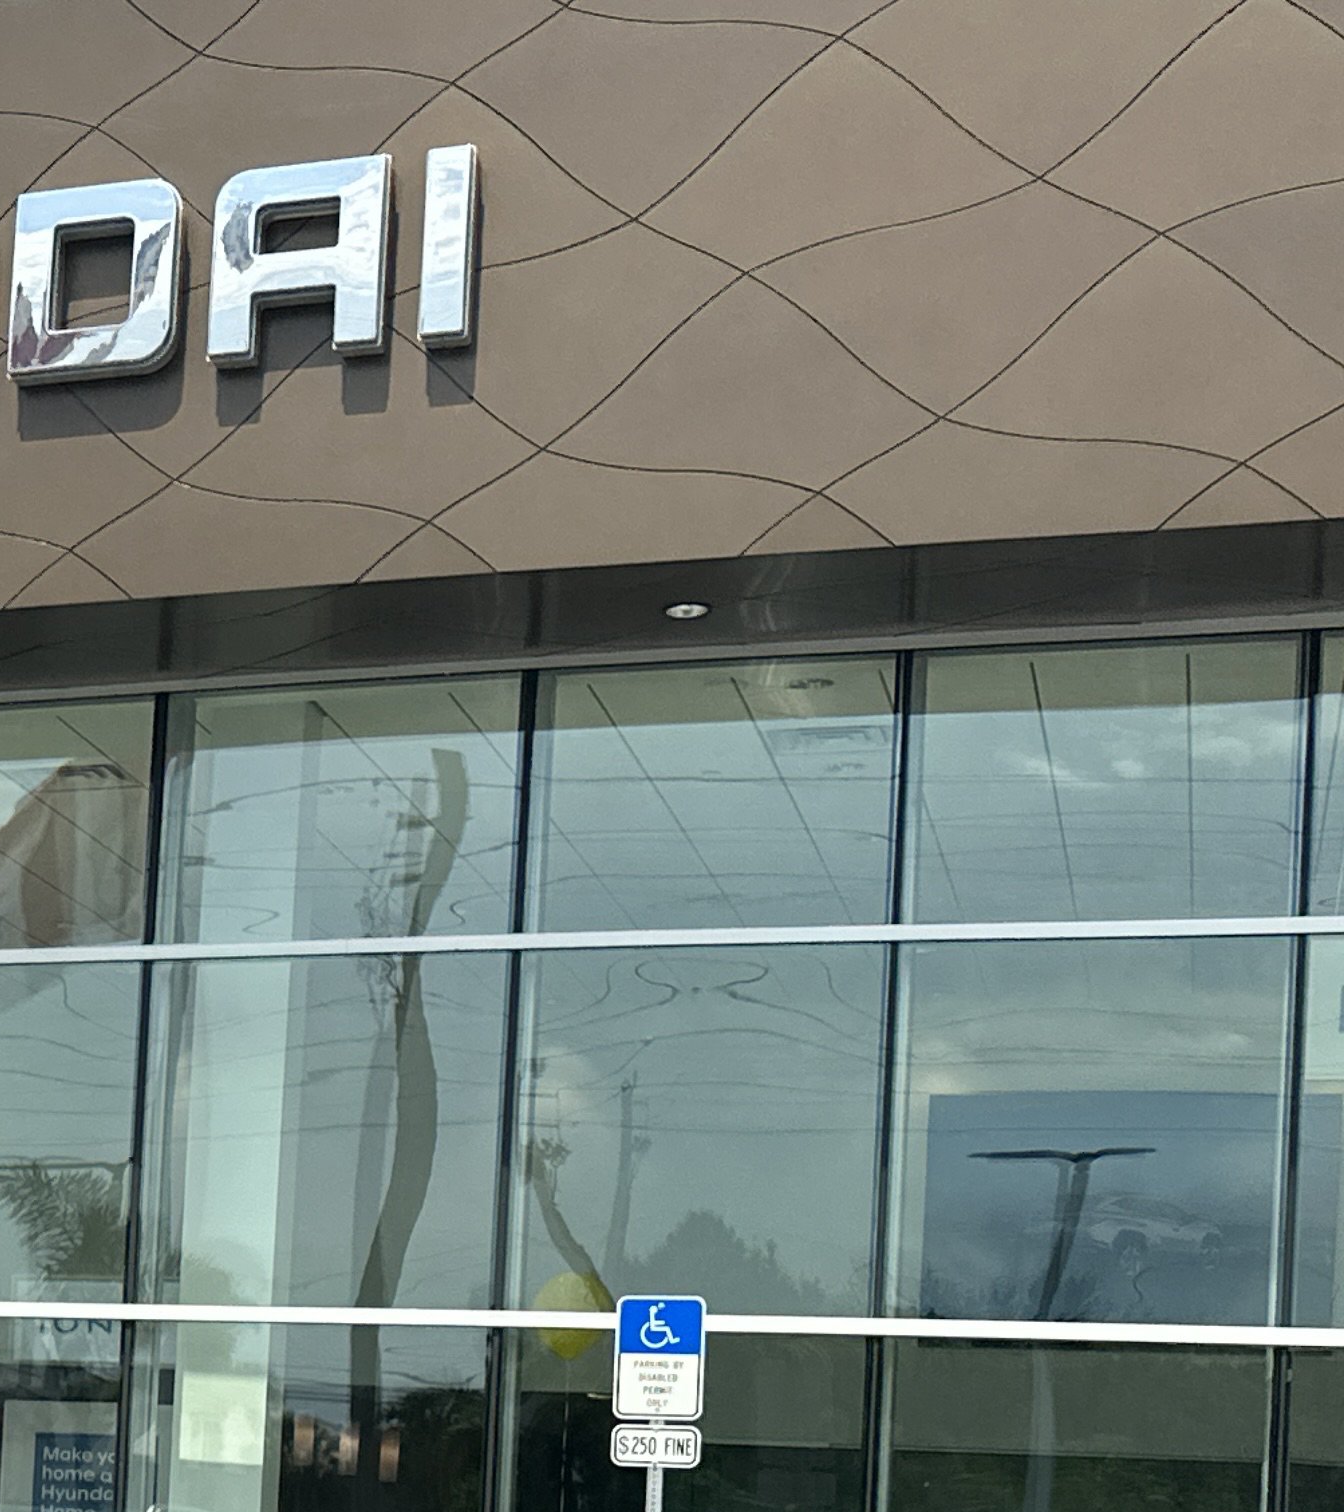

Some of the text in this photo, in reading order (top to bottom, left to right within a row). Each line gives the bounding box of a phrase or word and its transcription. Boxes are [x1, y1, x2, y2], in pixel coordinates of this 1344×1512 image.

[638, 1372, 678, 1382] DISABLED
[42, 1445, 93, 1463] Make
[618, 1435, 693, 1457] $250 FINE
[42, 1465, 95, 1482] home
